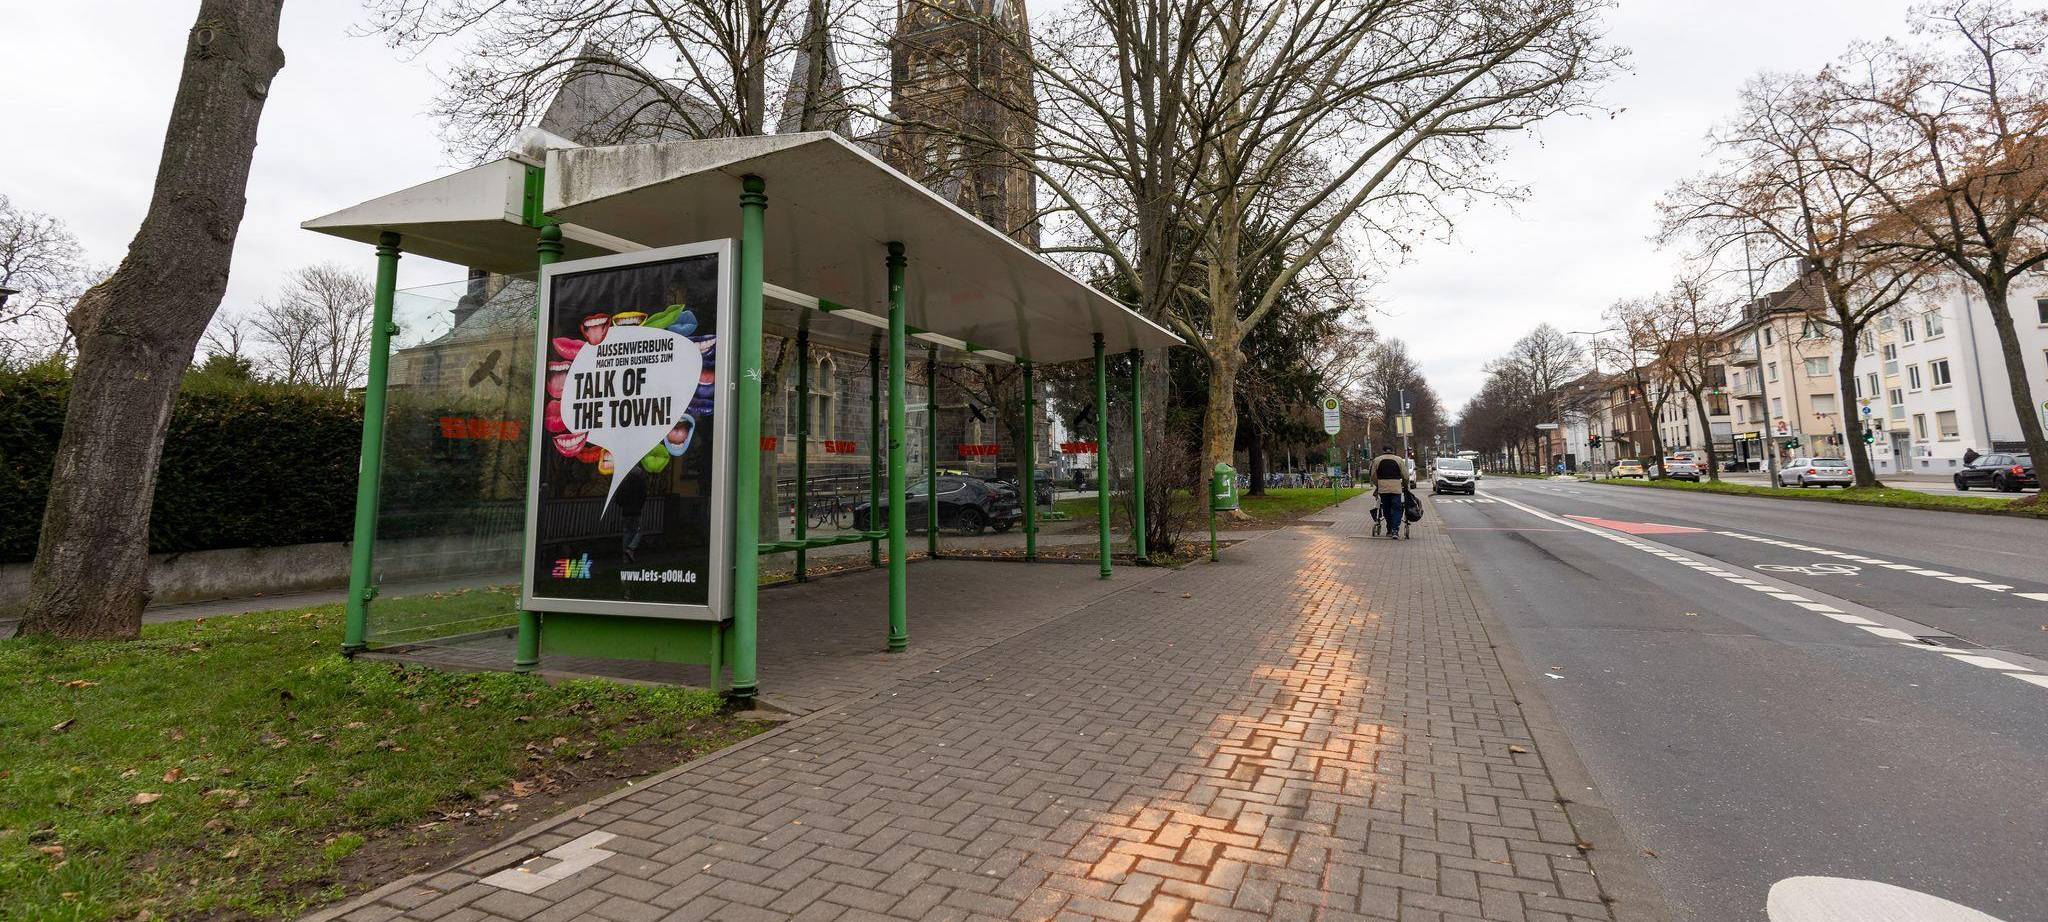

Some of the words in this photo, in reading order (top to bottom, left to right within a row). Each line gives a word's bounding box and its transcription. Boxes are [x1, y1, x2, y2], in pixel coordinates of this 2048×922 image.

[595, 359, 614, 369] MACHT
[615, 357, 630, 367] DEIN
[630, 354, 660, 366] BUSINESS
[660, 353, 674, 363] ZUM
[596, 338, 674, 358] AUSSENWERBUNG
[574, 370, 616, 400] TALK
[622, 367, 647, 397] OF
[572, 401, 604, 430] THE
[608, 396, 672, 429] TOWN!
[552, 552, 593, 579] awk
